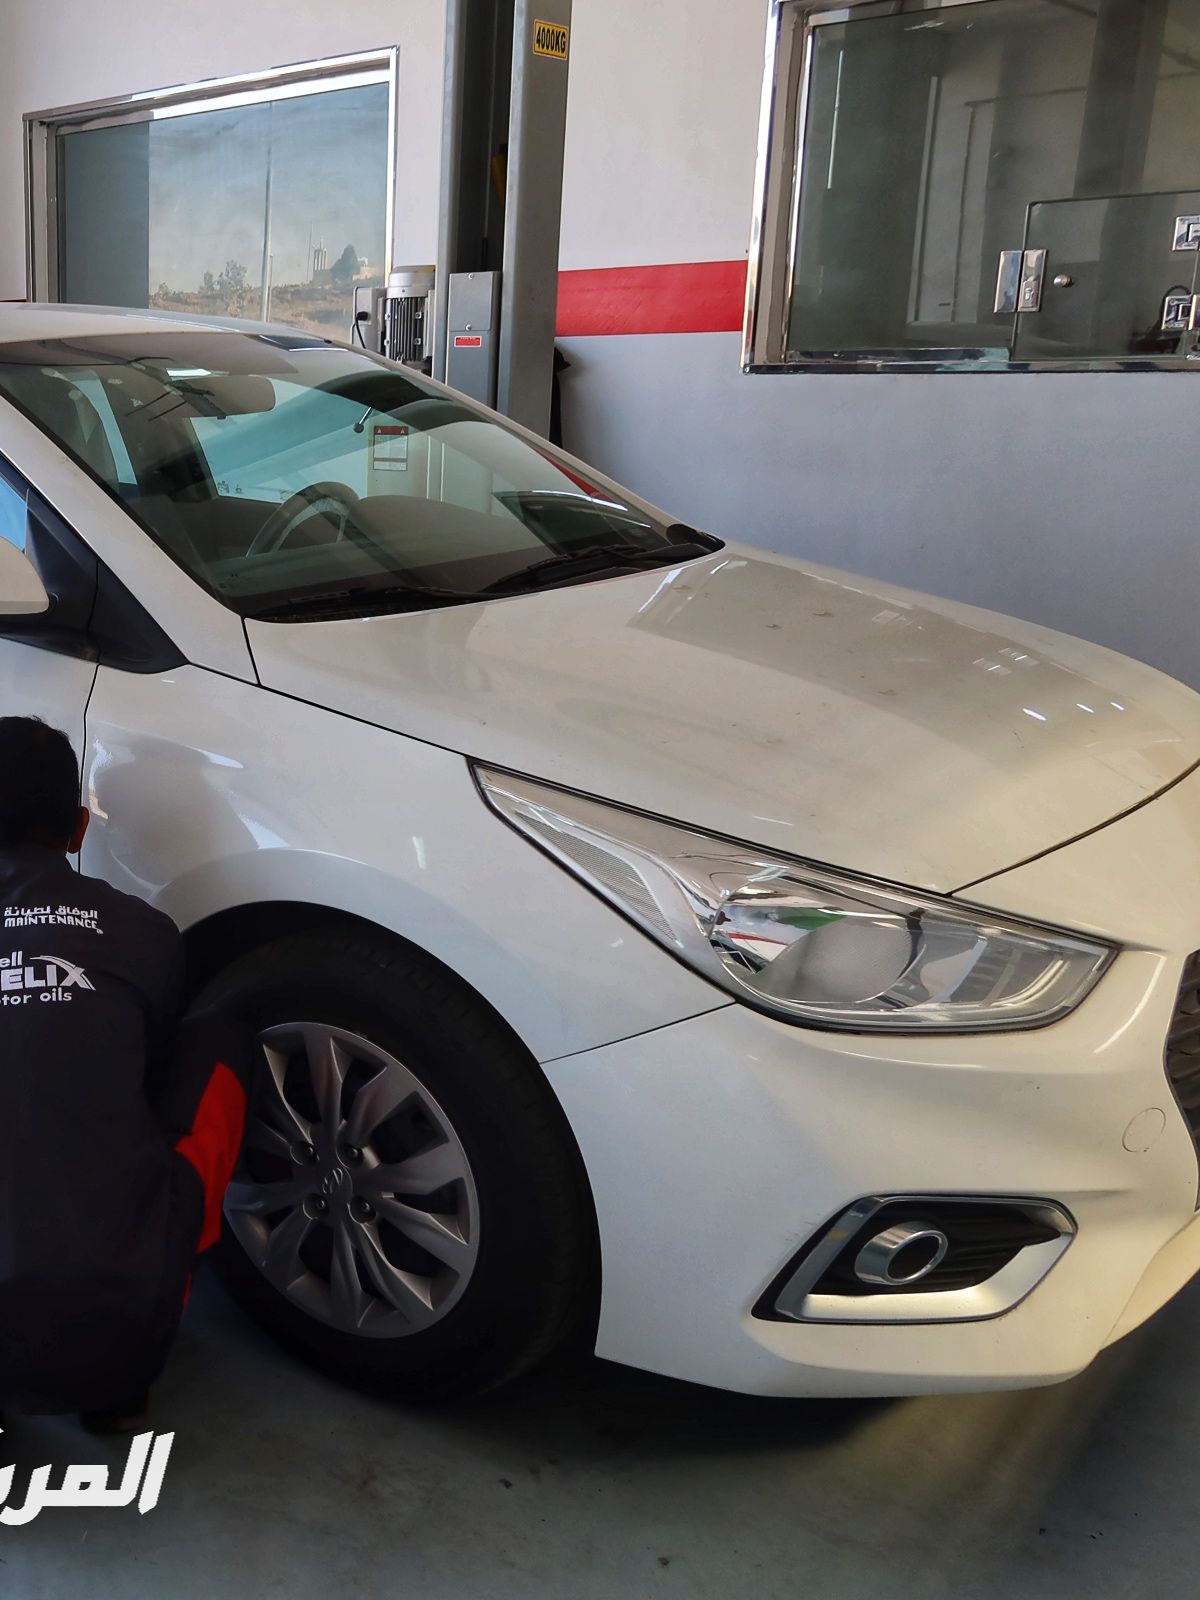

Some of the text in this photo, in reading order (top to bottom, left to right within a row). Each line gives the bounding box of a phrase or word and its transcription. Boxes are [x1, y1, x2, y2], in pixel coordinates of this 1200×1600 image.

[536, 26, 566, 53] 4000KG
[4, 905, 51, 917] لصيانة
[55, 905, 98, 919] الوفاق
[4, 915, 98, 930] MAINTENANCE
[40, 986, 73, 1002] oils
